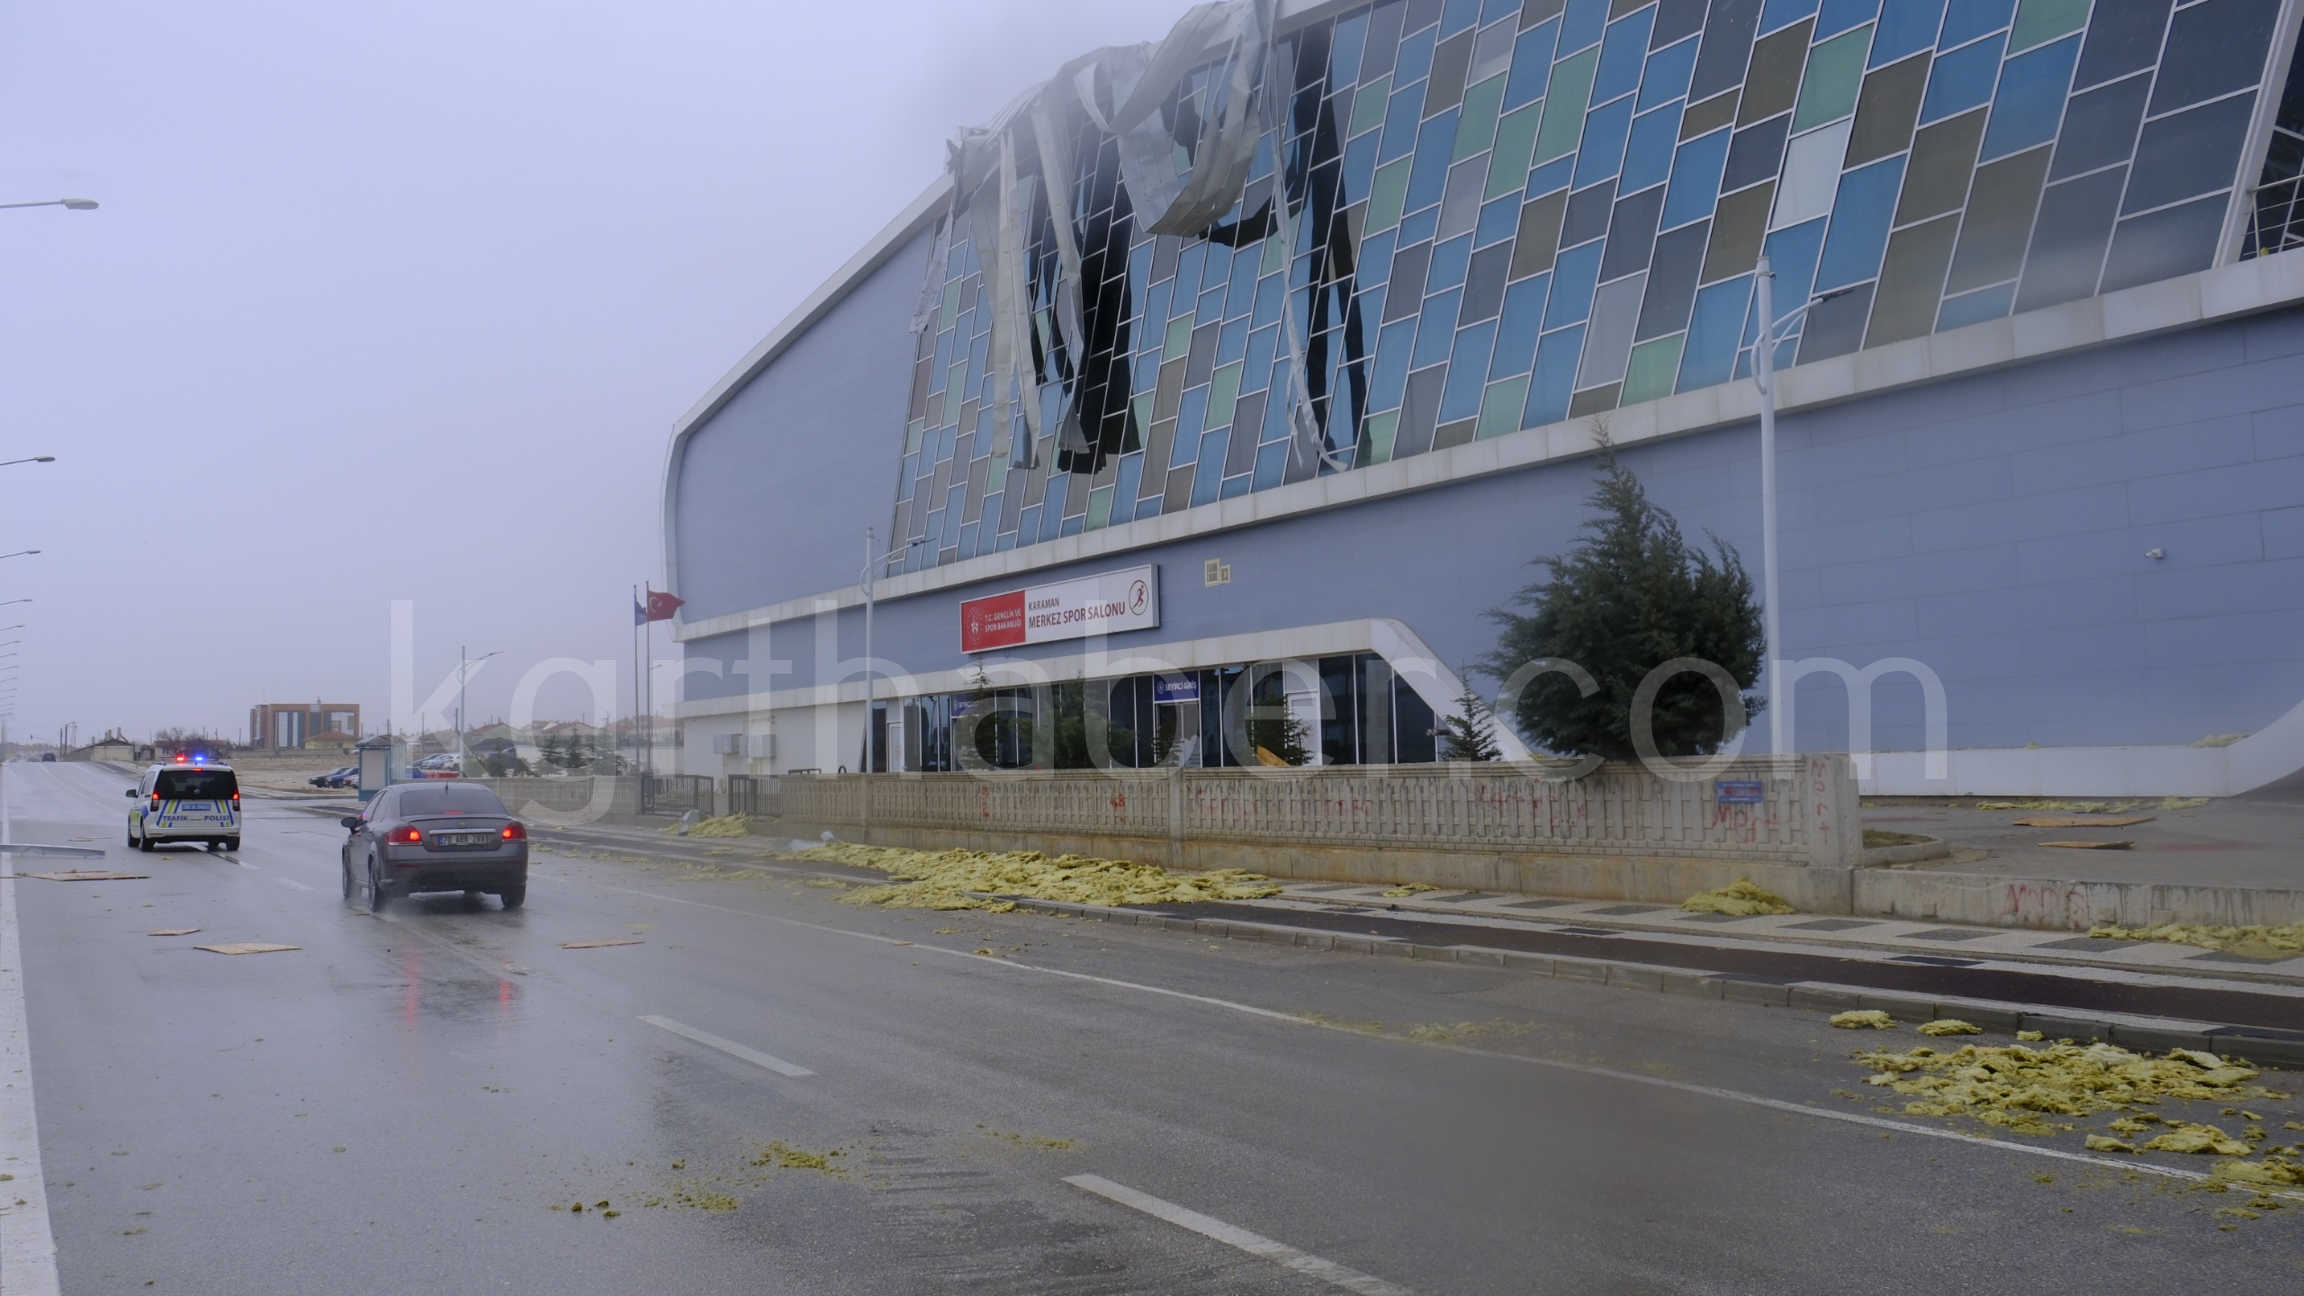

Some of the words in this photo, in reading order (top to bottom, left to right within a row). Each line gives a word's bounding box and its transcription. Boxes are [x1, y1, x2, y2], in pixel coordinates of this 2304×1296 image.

[1028, 598, 1060, 611] KARAMAN
[1028, 612, 1062, 629] MERKEZ
[1063, 607, 1086, 625] SPOR
[1087, 601, 1126, 620] SALONU
